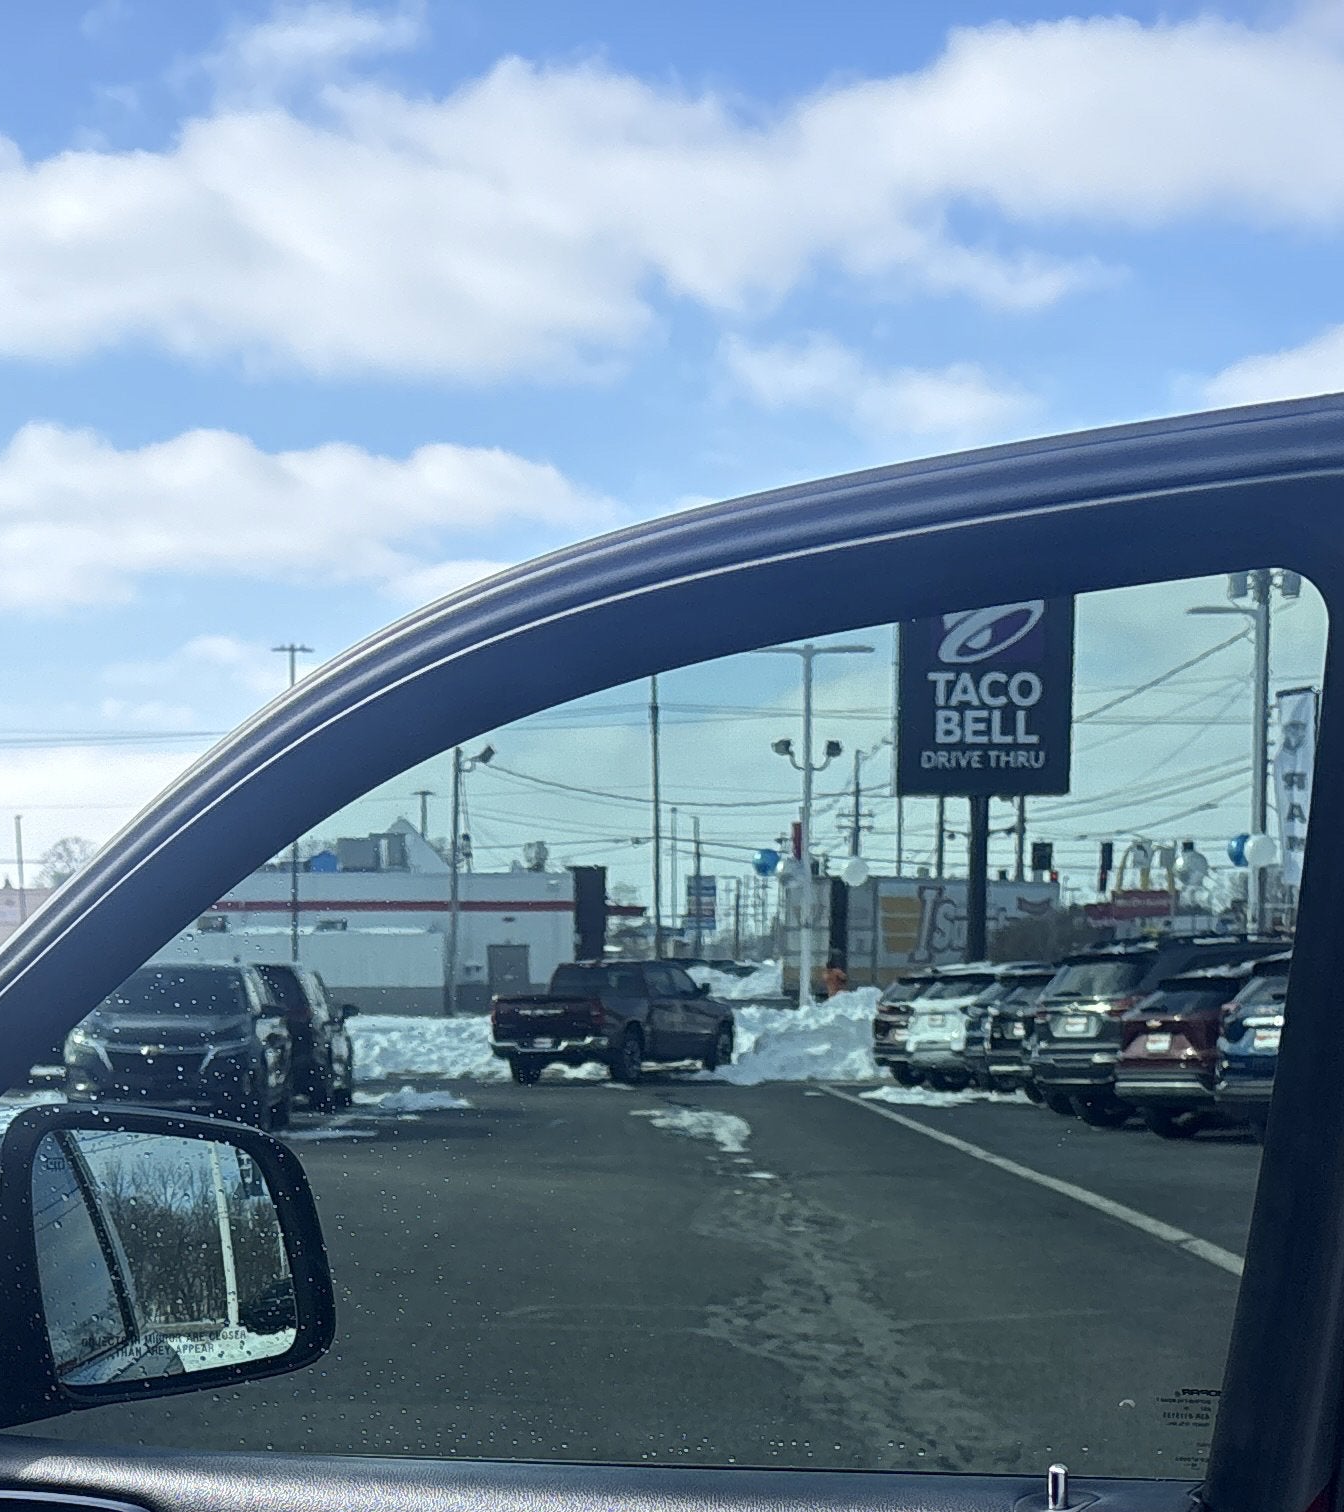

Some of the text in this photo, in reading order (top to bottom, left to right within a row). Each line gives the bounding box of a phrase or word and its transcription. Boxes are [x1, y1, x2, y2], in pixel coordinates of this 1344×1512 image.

[927, 671, 1043, 707] TACO
[935, 709, 1040, 744] BELL
[920, 751, 1046, 769] DRIVE THRU
[186, 1331, 206, 1342] ARE
[209, 1329, 247, 1341] CLOSER
[176, 1344, 214, 1354] APPEAR
